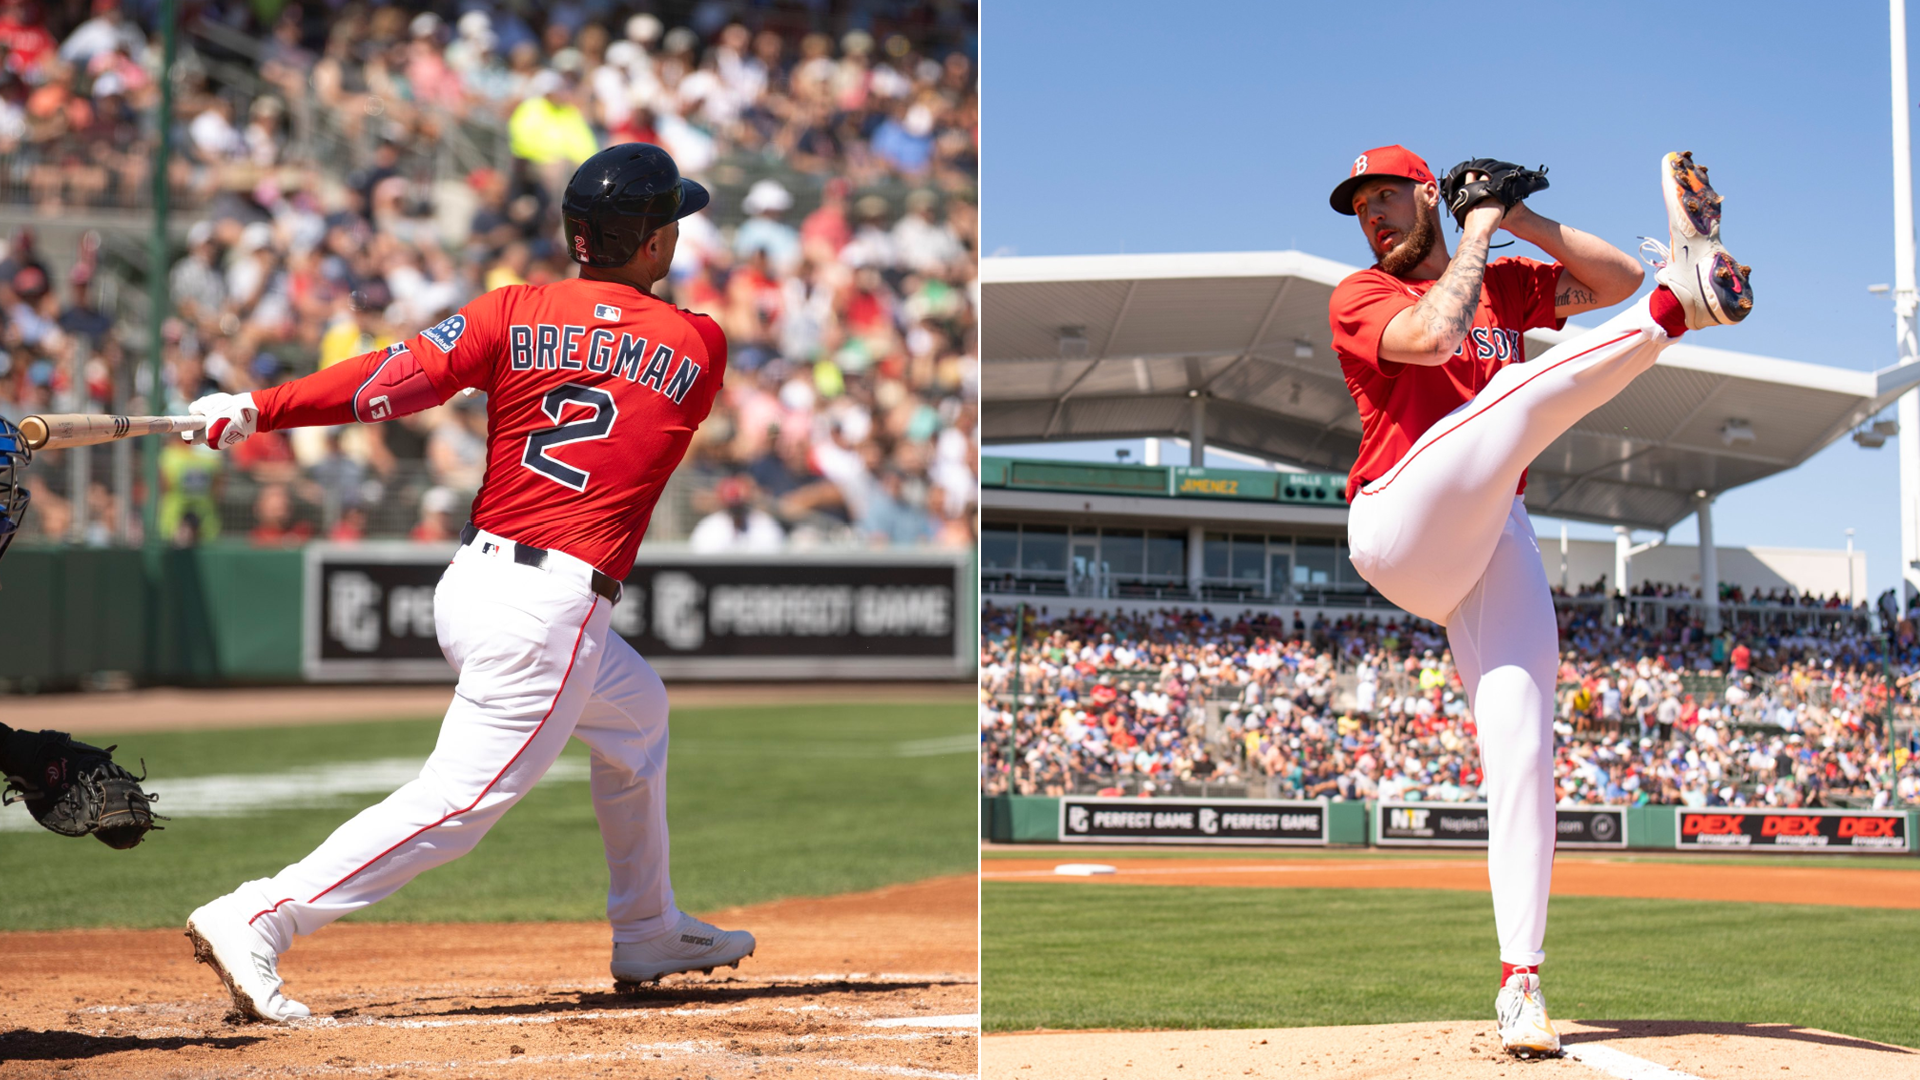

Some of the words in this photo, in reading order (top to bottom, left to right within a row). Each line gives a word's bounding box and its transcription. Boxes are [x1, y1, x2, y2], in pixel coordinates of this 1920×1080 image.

[1354, 154, 1368, 176] B
[574, 235, 586, 253] 2
[1472, 326, 1520, 362] SOX
[510, 324, 701, 405] BREGMAN
[520, 382, 619, 493] 2
[1180, 478, 1239, 495] JIMENEZ
[1289, 475, 1322, 486] BALLS
[709, 585, 850, 637] PERFECT
[854, 585, 950, 637] GAME
[1094, 812, 1152, 828] PERFECT
[1154, 812, 1194, 829] GAME
[1222, 813, 1279, 830] PERFECT
[1281, 814, 1319, 831] GAME
[1682, 814, 1746, 835] DEX
[1761, 815, 1822, 836] DEX
[1837, 817, 1897, 837] DEX
[681, 934, 714, 947] marucci
